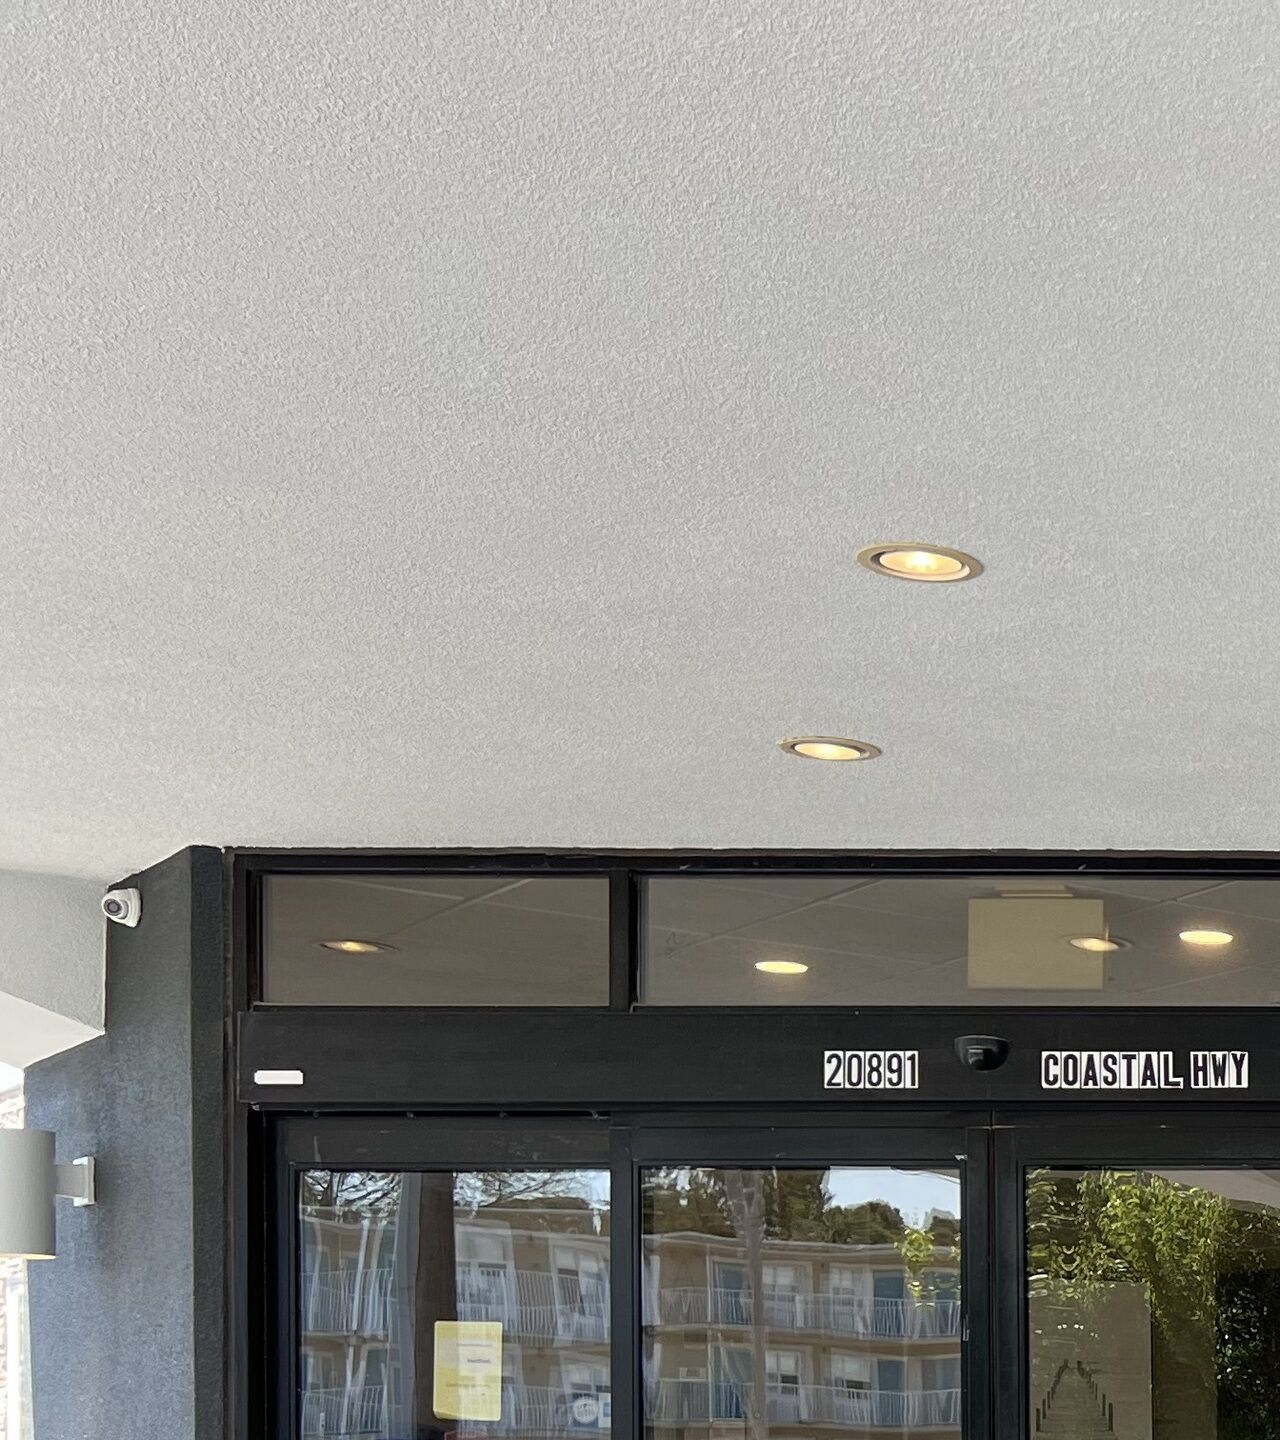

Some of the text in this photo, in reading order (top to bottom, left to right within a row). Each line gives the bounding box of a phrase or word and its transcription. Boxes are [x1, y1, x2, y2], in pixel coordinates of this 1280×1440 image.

[825, 1052, 918, 1088] 20891
[1042, 1051, 1247, 1088] COASTAL HWY
